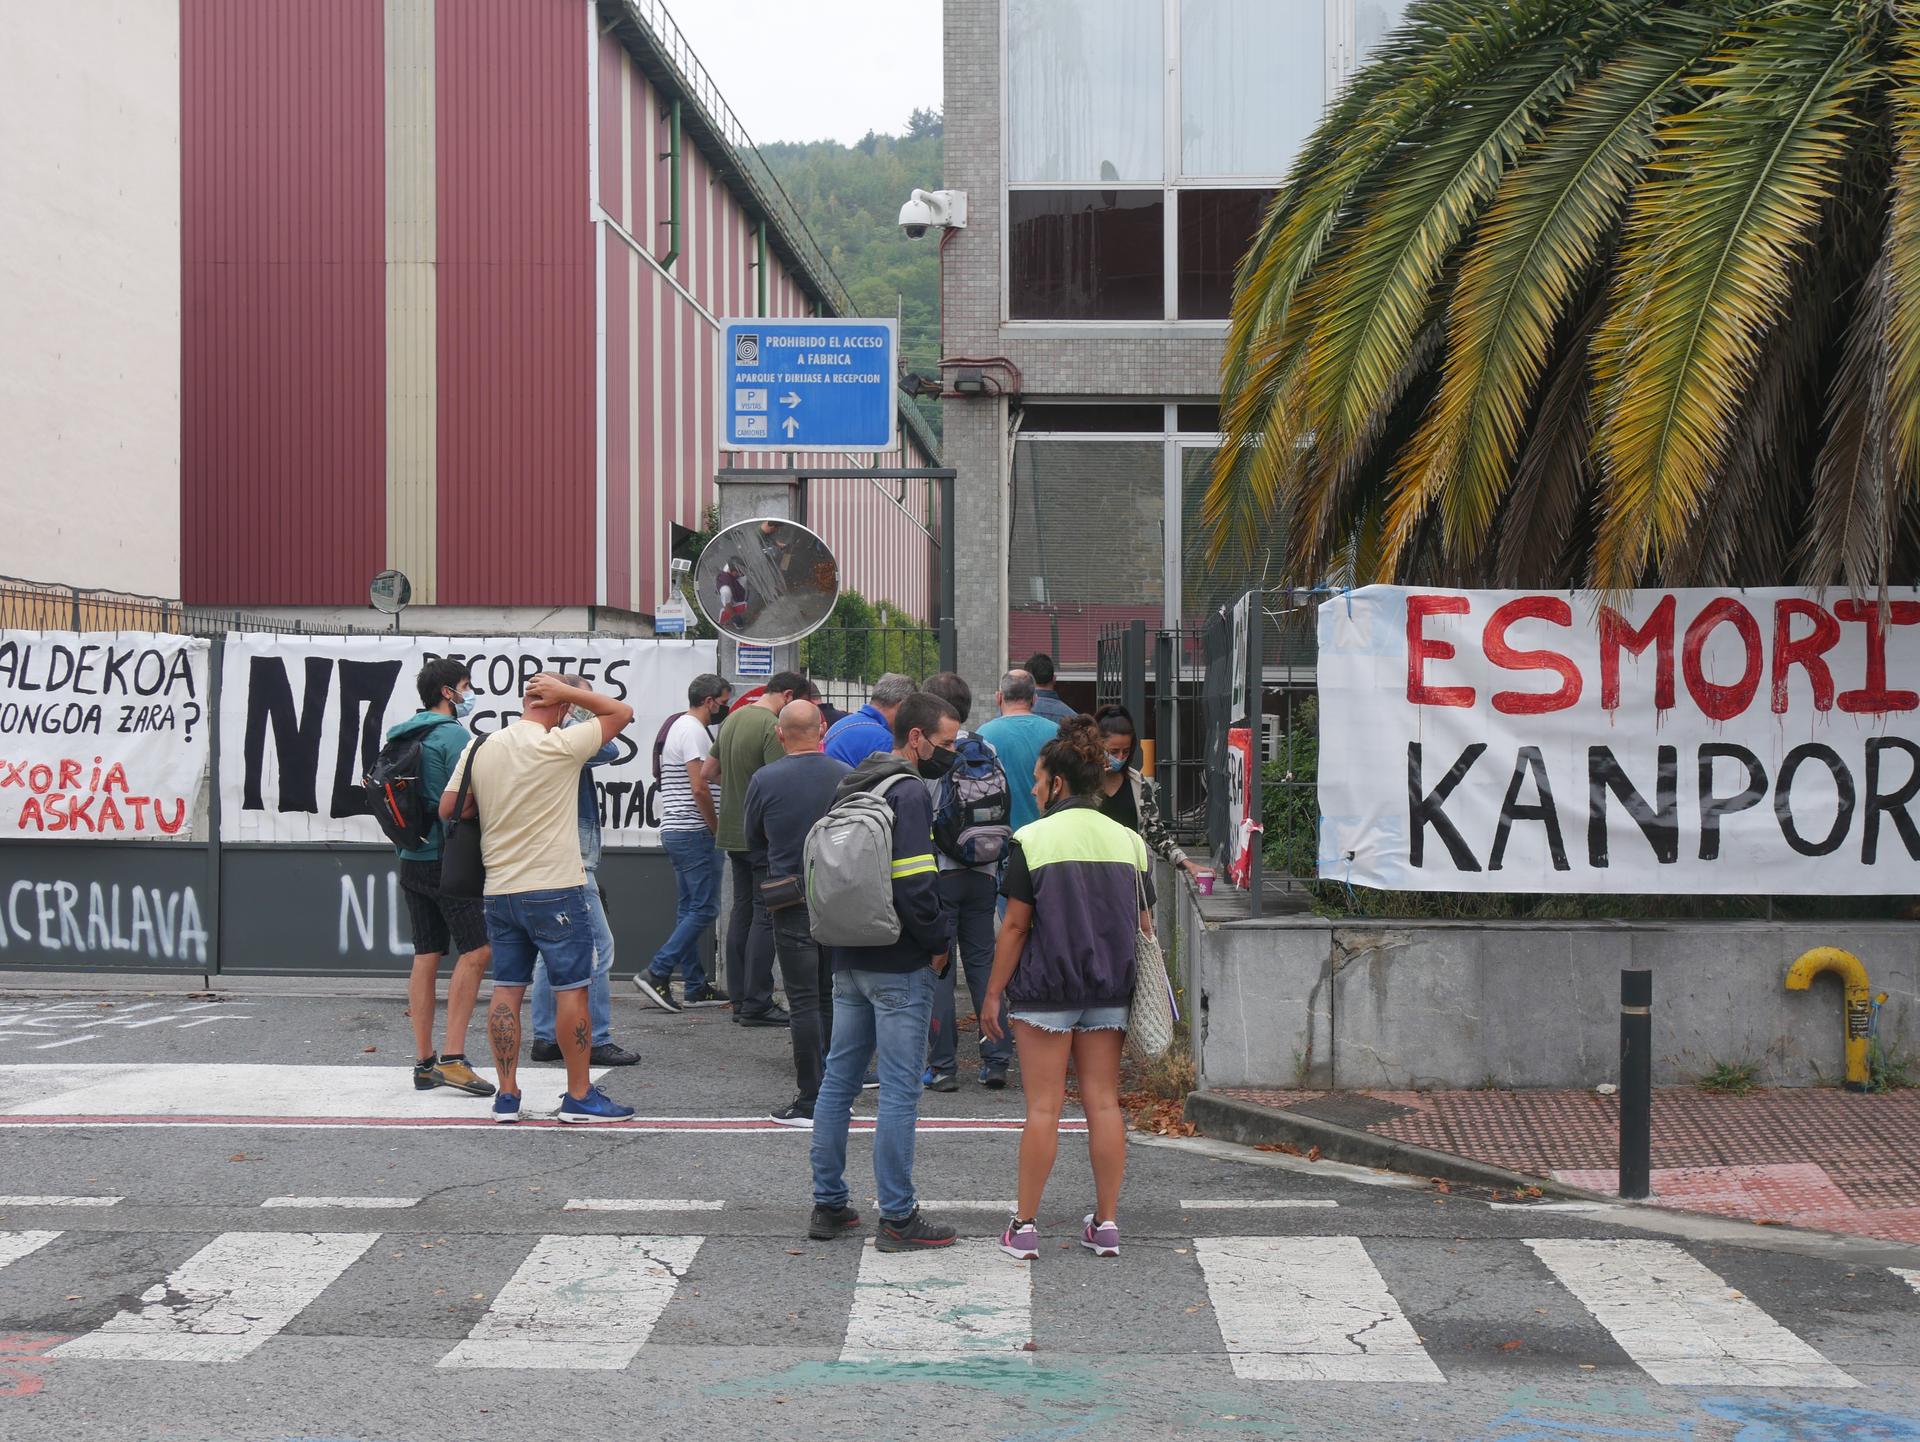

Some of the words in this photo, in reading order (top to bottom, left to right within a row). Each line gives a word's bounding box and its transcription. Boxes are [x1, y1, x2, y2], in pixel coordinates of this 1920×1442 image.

[766, 336, 826, 348] PROHIBIDO
[829, 336, 841, 348] EL
[843, 336, 883, 348] ACCESO
[797, 354, 805, 365] A
[808, 354, 852, 365] FABRICA
[736, 373, 775, 383] APARQUE
[777, 373, 783, 383] Y
[785, 373, 823, 383] DIRIJASE
[824, 373, 831, 383] A
[833, 373, 880, 383] RECEPCION
[748, 391, 756, 400] P
[747, 418, 756, 427] P
[0, 703, 100, 735] ONGOA
[242, 656, 402, 818] NO
[18, 793, 186, 833] ASKATU
[1408, 737, 1920, 872] KANPOR
[0, 880, 209, 962] CERALAVA
